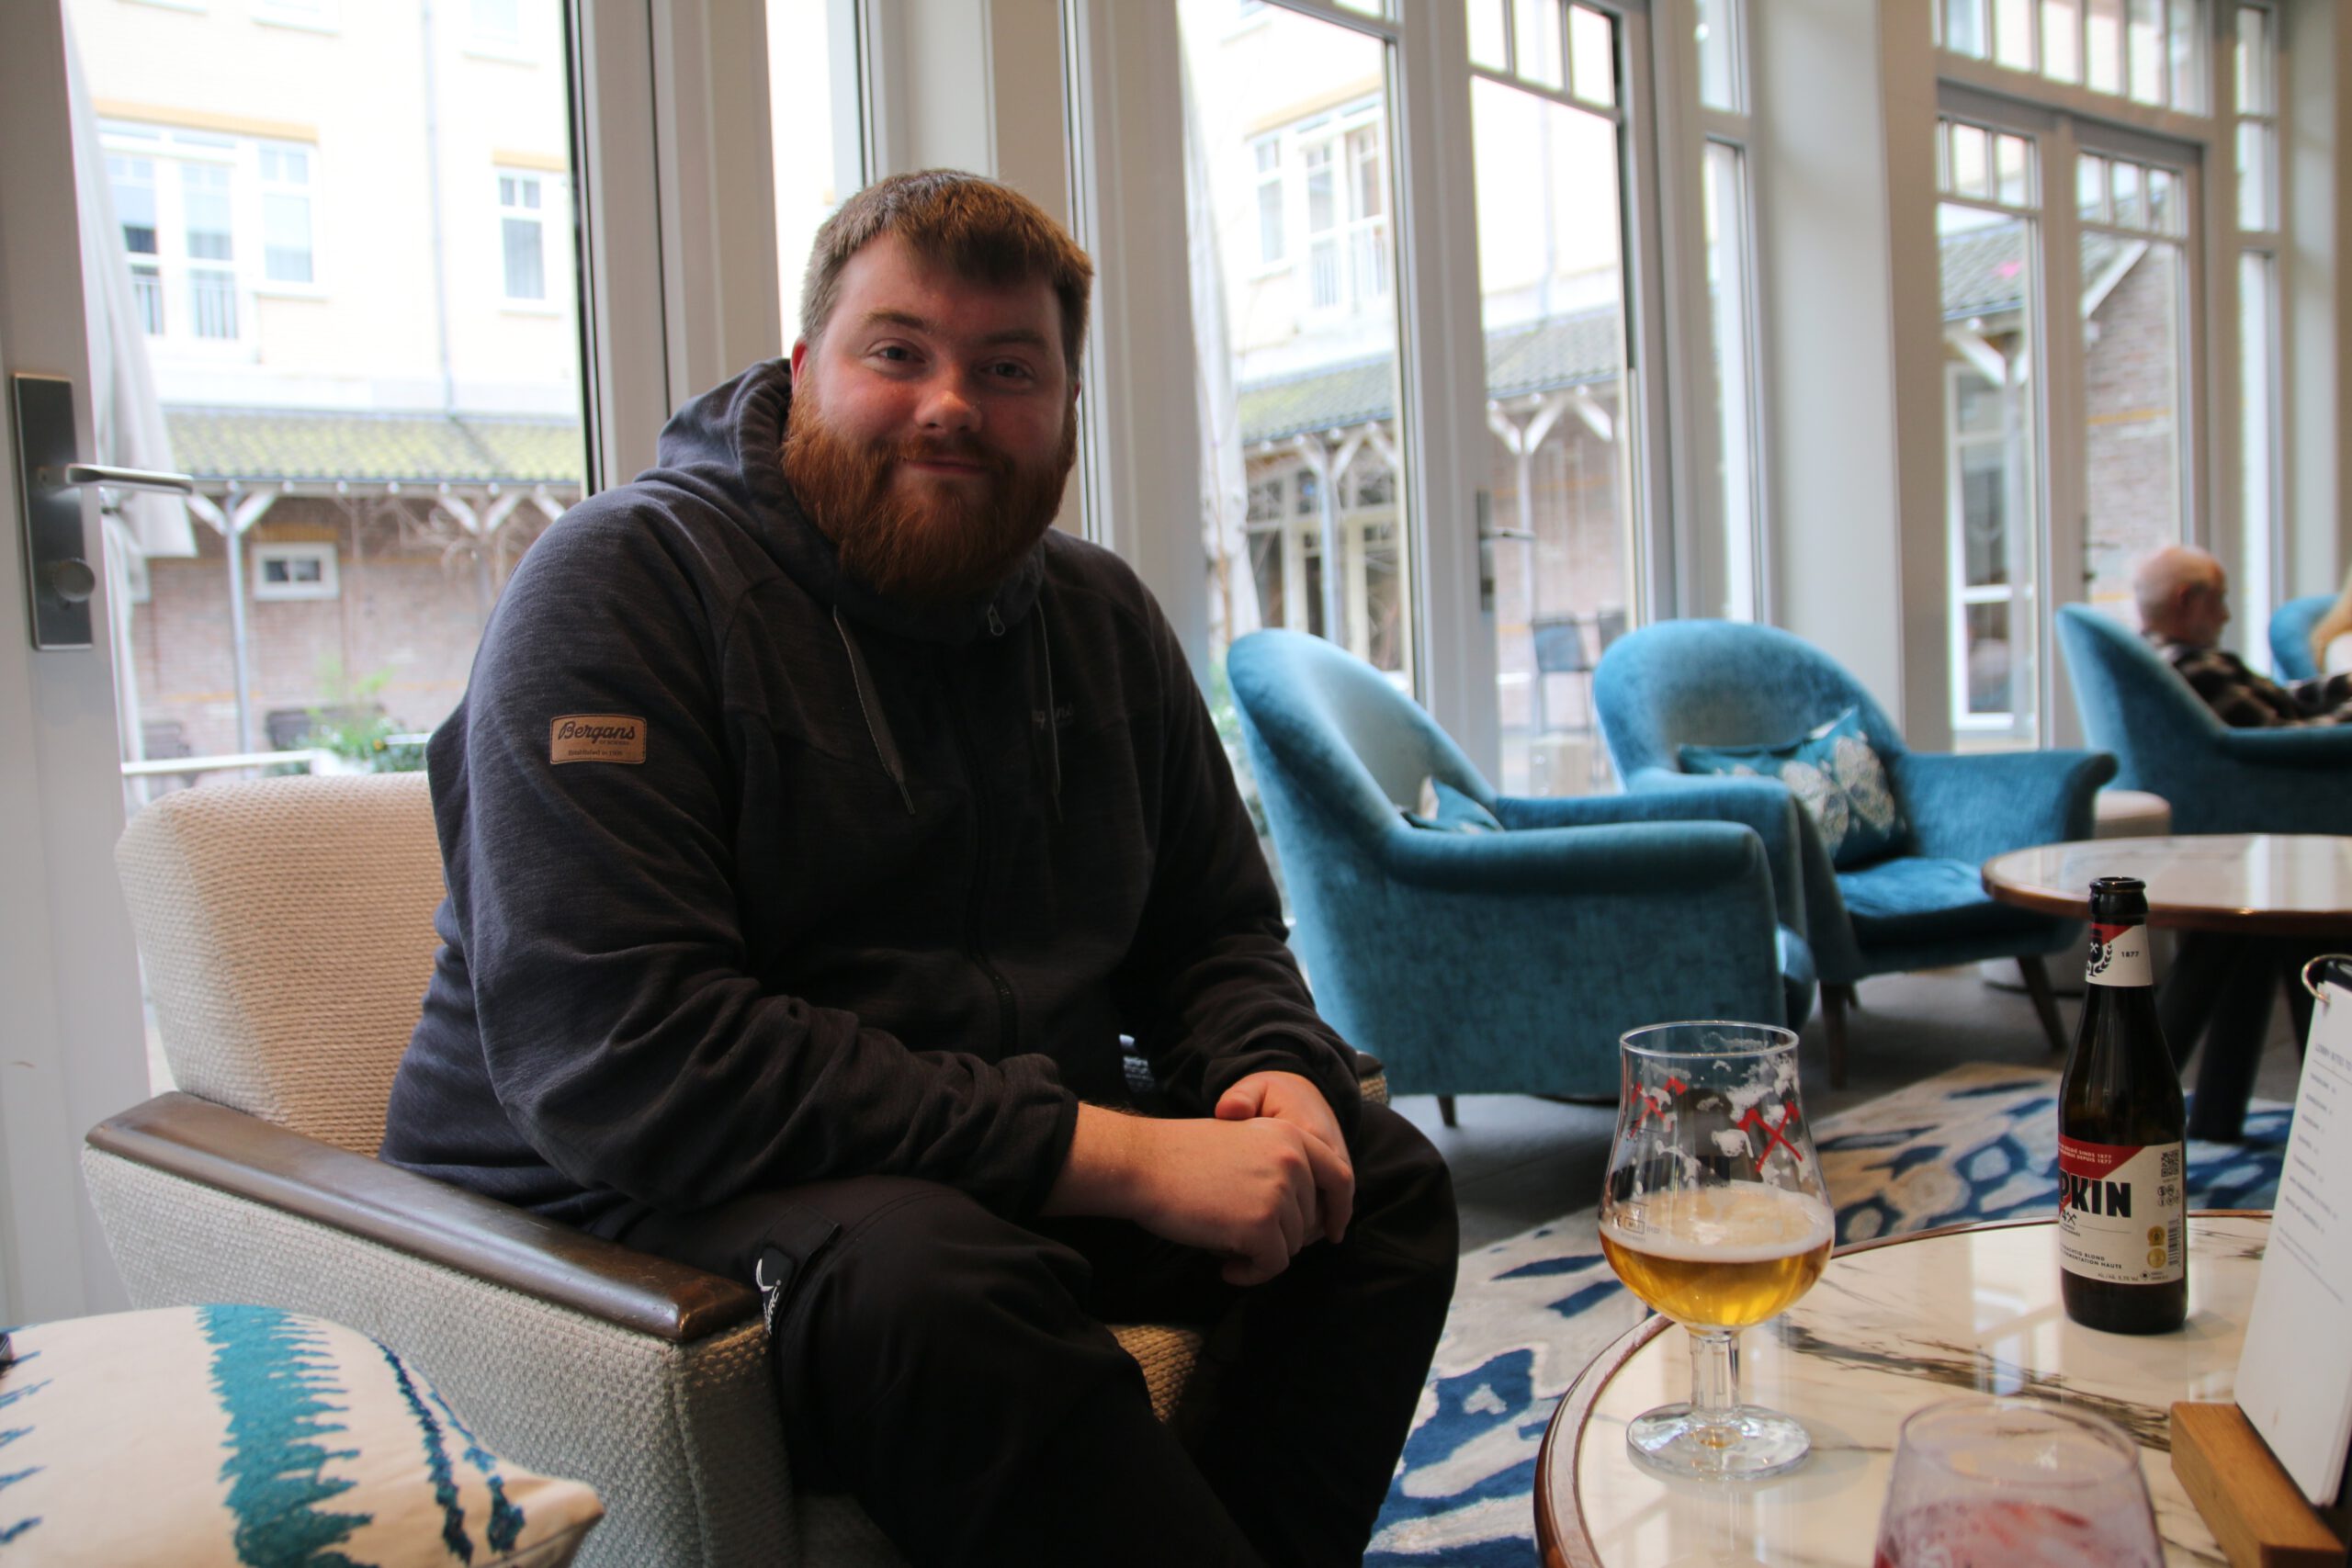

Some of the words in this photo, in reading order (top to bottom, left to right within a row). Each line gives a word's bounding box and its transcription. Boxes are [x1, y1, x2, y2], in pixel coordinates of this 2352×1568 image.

[558, 720, 636, 744] Bergans
[2085, 1252, 2105, 1261] BLOND
[2101, 1261, 2122, 1269] HAUTE
